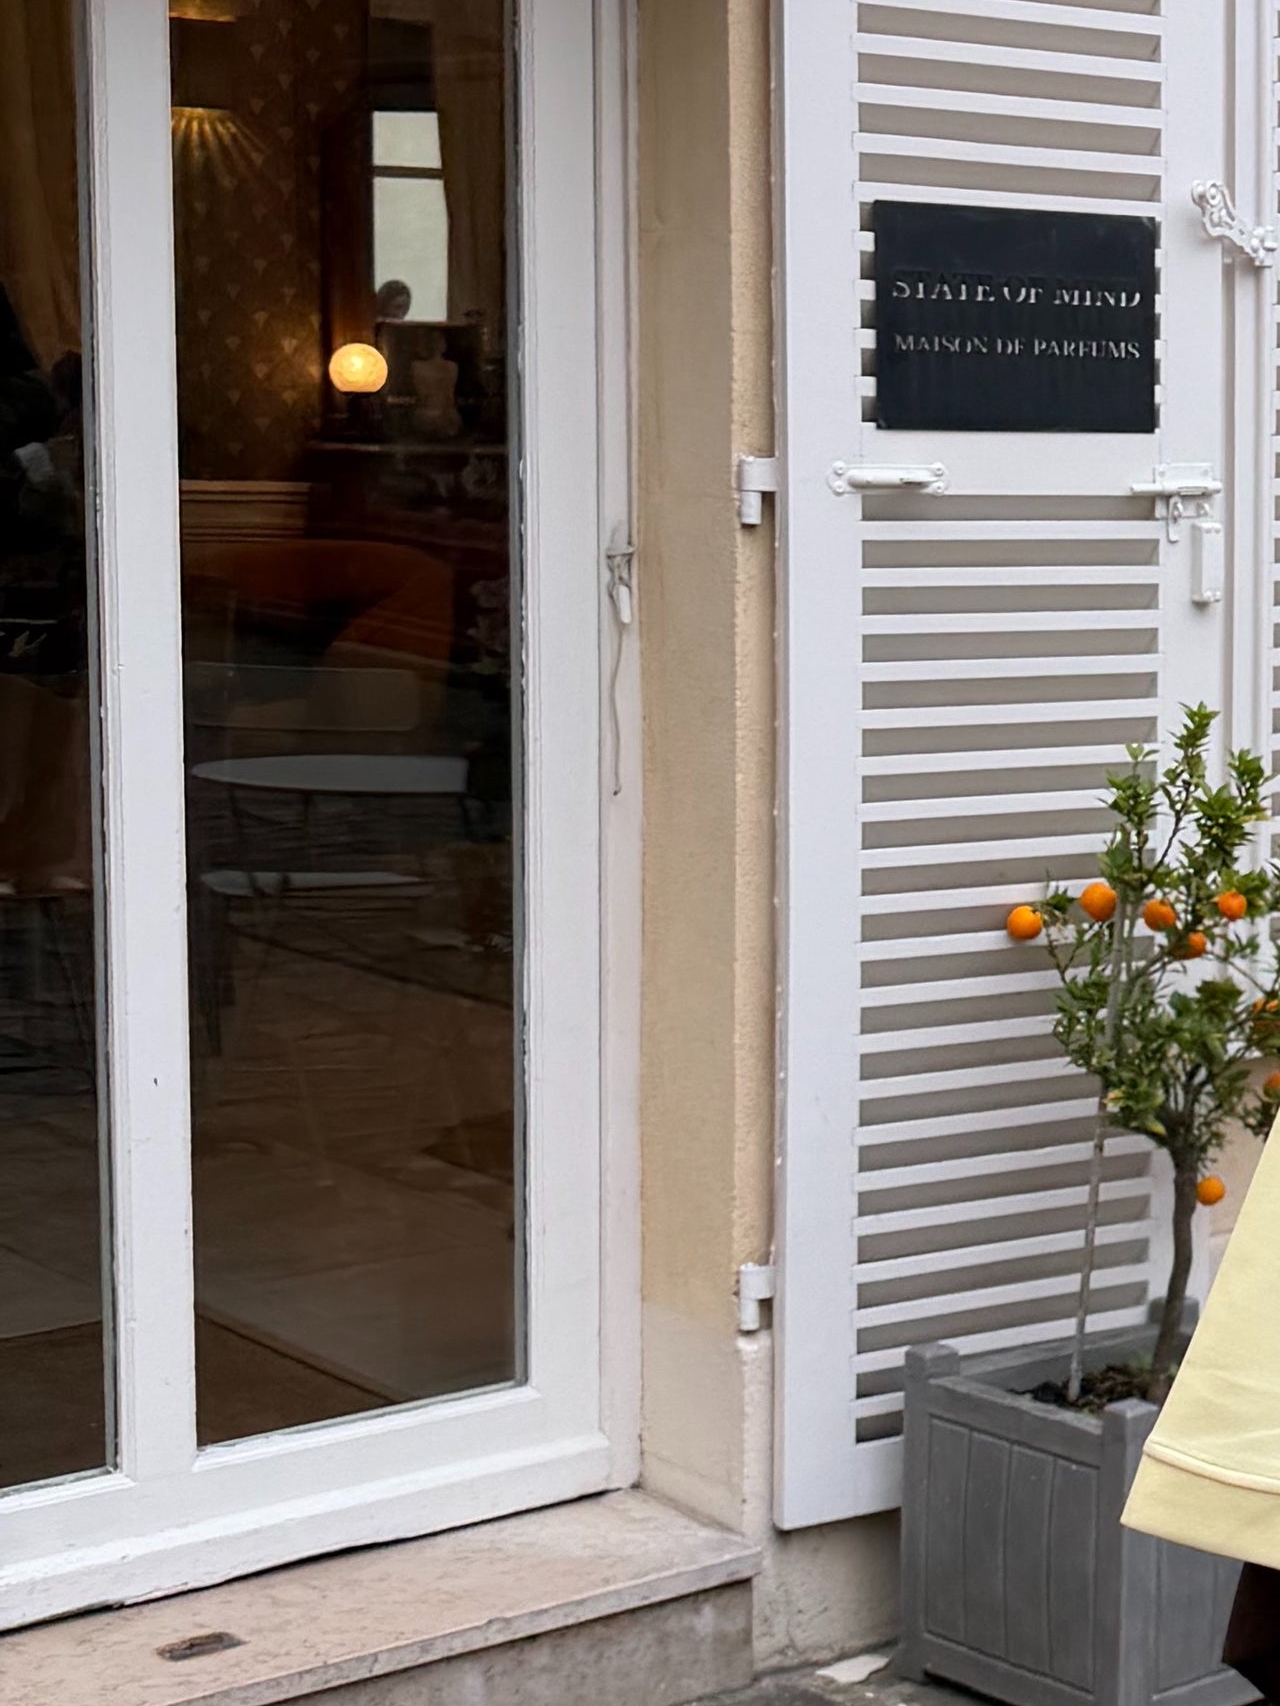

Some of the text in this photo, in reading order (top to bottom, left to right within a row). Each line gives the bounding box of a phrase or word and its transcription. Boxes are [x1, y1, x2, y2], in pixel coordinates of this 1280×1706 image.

[891, 270, 1141, 308] STATE OF MIND
[893, 333, 989, 354] MAISON
[1034, 338, 1141, 359] PARFUMS
